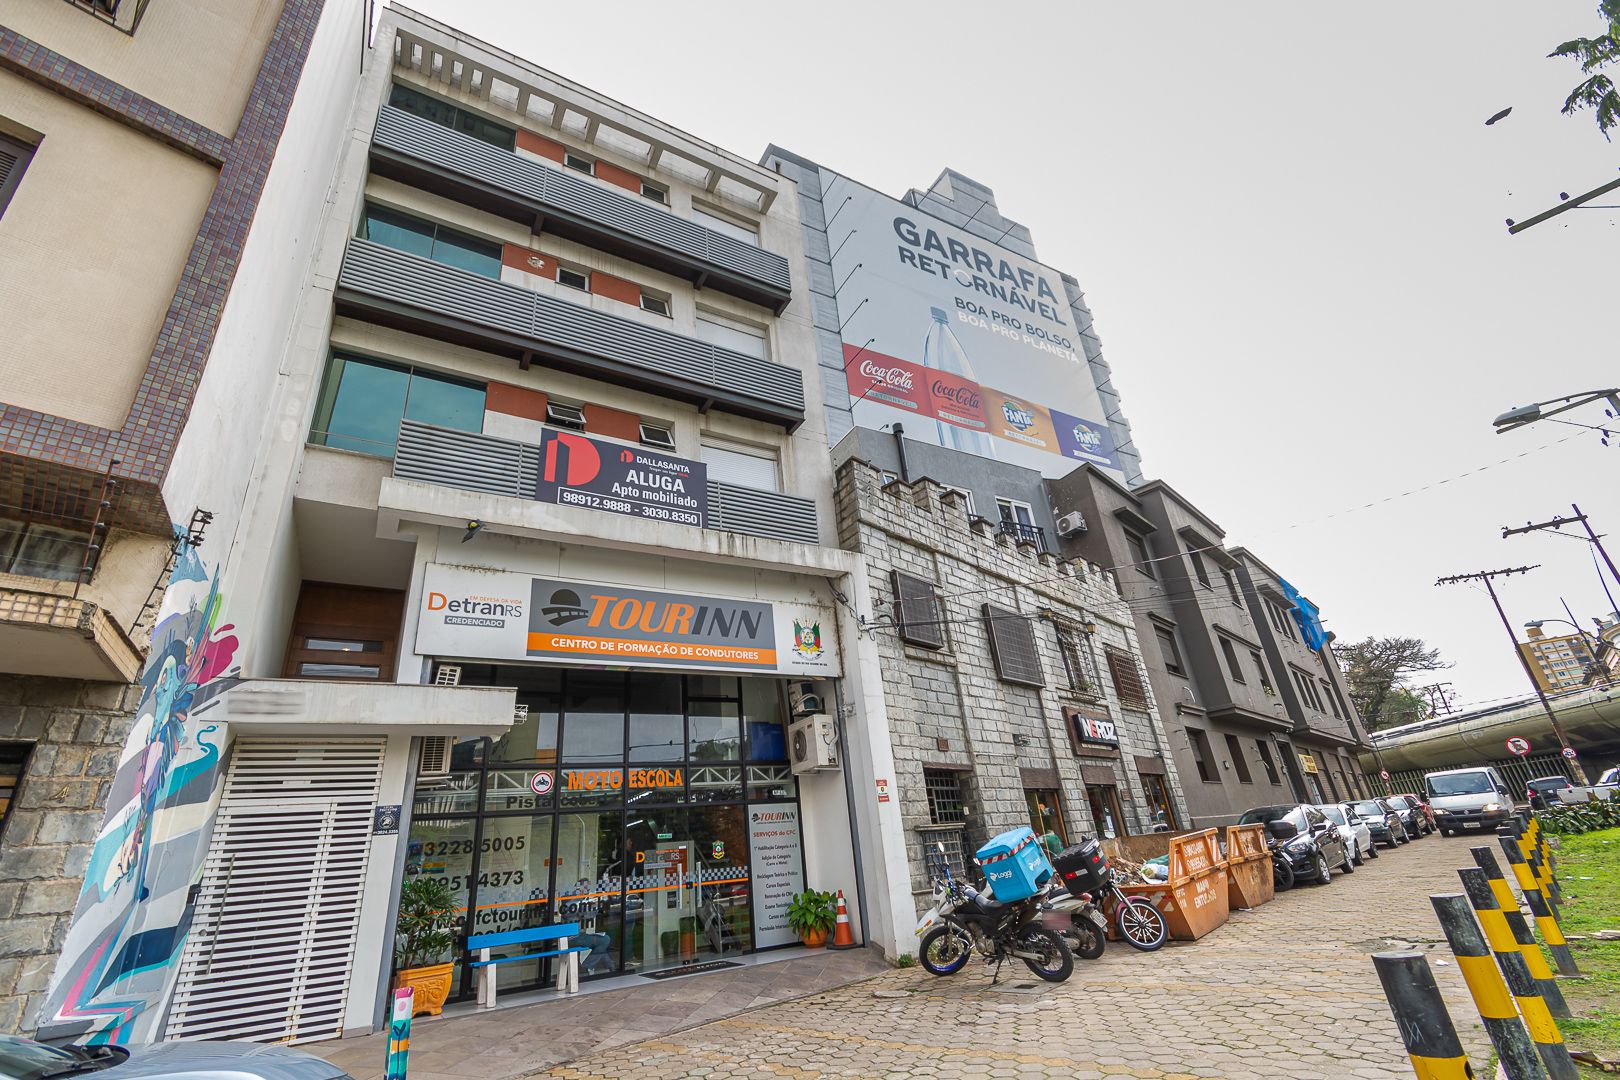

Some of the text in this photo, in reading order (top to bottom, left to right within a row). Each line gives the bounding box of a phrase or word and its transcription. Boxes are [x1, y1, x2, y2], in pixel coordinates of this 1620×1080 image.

[893, 217, 1058, 305] GARRAFA
[898, 246, 1066, 326] RETORNÁVEL
[954, 297, 1075, 352] BOA PRO BOLSO,
[958, 311, 1080, 363] BOA PRO PLANETA
[636, 456, 690, 473] DALLASANTA
[625, 469, 686, 493] ALUGA
[612, 482, 698, 508] Apto mobiliado
[563, 492, 632, 513] 98912.9888
[642, 506, 698, 524] 3030.8350
[446, 616, 503, 627] CREDENCIADO
[551, 637, 759, 660] CENTRO DE FORMAÇÃO DE CONDUTORES
[567, 769, 684, 790] MOTO ESCOLA
[506, 795, 551, 809] Pista
[424, 836, 525, 857] 3228 5005
[477, 870, 524, 887] 4373
